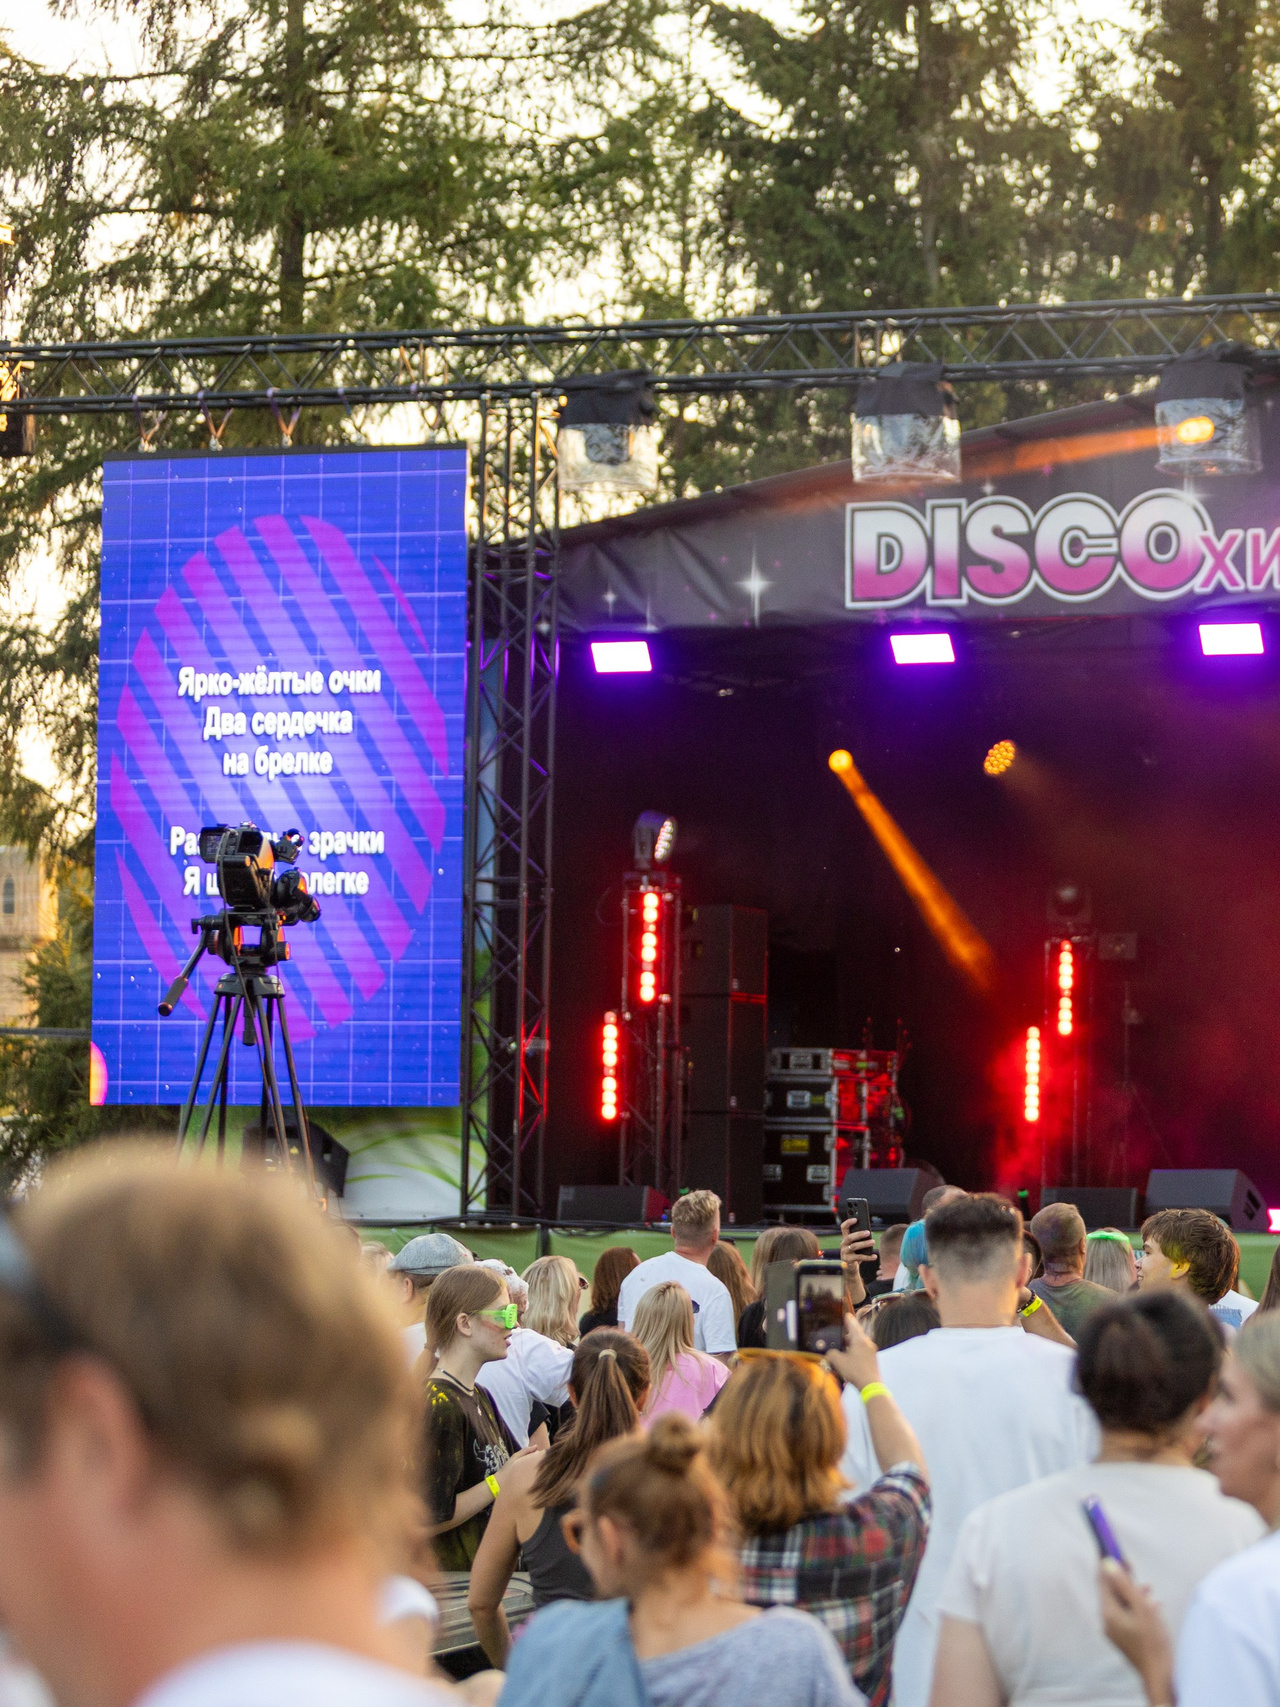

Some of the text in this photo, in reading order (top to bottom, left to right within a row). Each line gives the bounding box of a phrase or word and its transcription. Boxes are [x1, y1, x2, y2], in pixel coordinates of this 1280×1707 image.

[844, 486, 1214, 609] DISCO
[178, 665, 382, 702] Ярко-жёлтые очки
[203, 706, 353, 742] Два сердечка
[222, 745, 333, 782] на брелке
[308, 830, 385, 860] зрачки
[183, 865, 201, 896] Я
